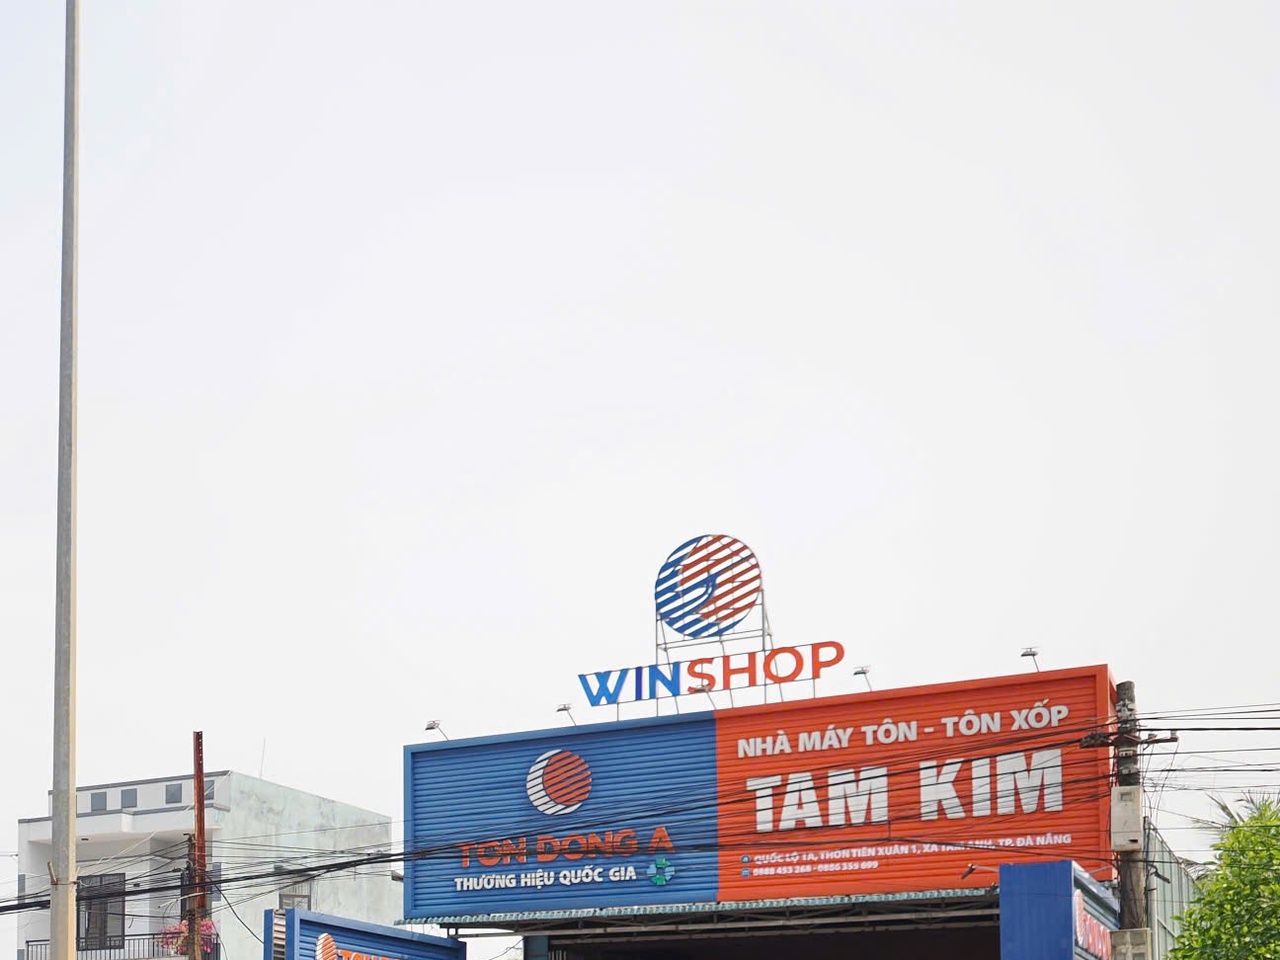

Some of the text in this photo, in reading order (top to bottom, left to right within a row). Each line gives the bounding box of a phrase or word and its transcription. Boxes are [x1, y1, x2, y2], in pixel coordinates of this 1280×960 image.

[578, 640, 845, 707] WINSHOP
[737, 730, 792, 758] NHÀ
[797, 724, 854, 753] MÁY
[861, 718, 918, 746] TÔN
[941, 710, 1001, 737] TÔN
[1010, 698, 1069, 731] XỐP
[746, 748, 1063, 833] TAM KIM
[454, 865, 637, 891] THƯƠNG HIỆU QUỐC GIA
